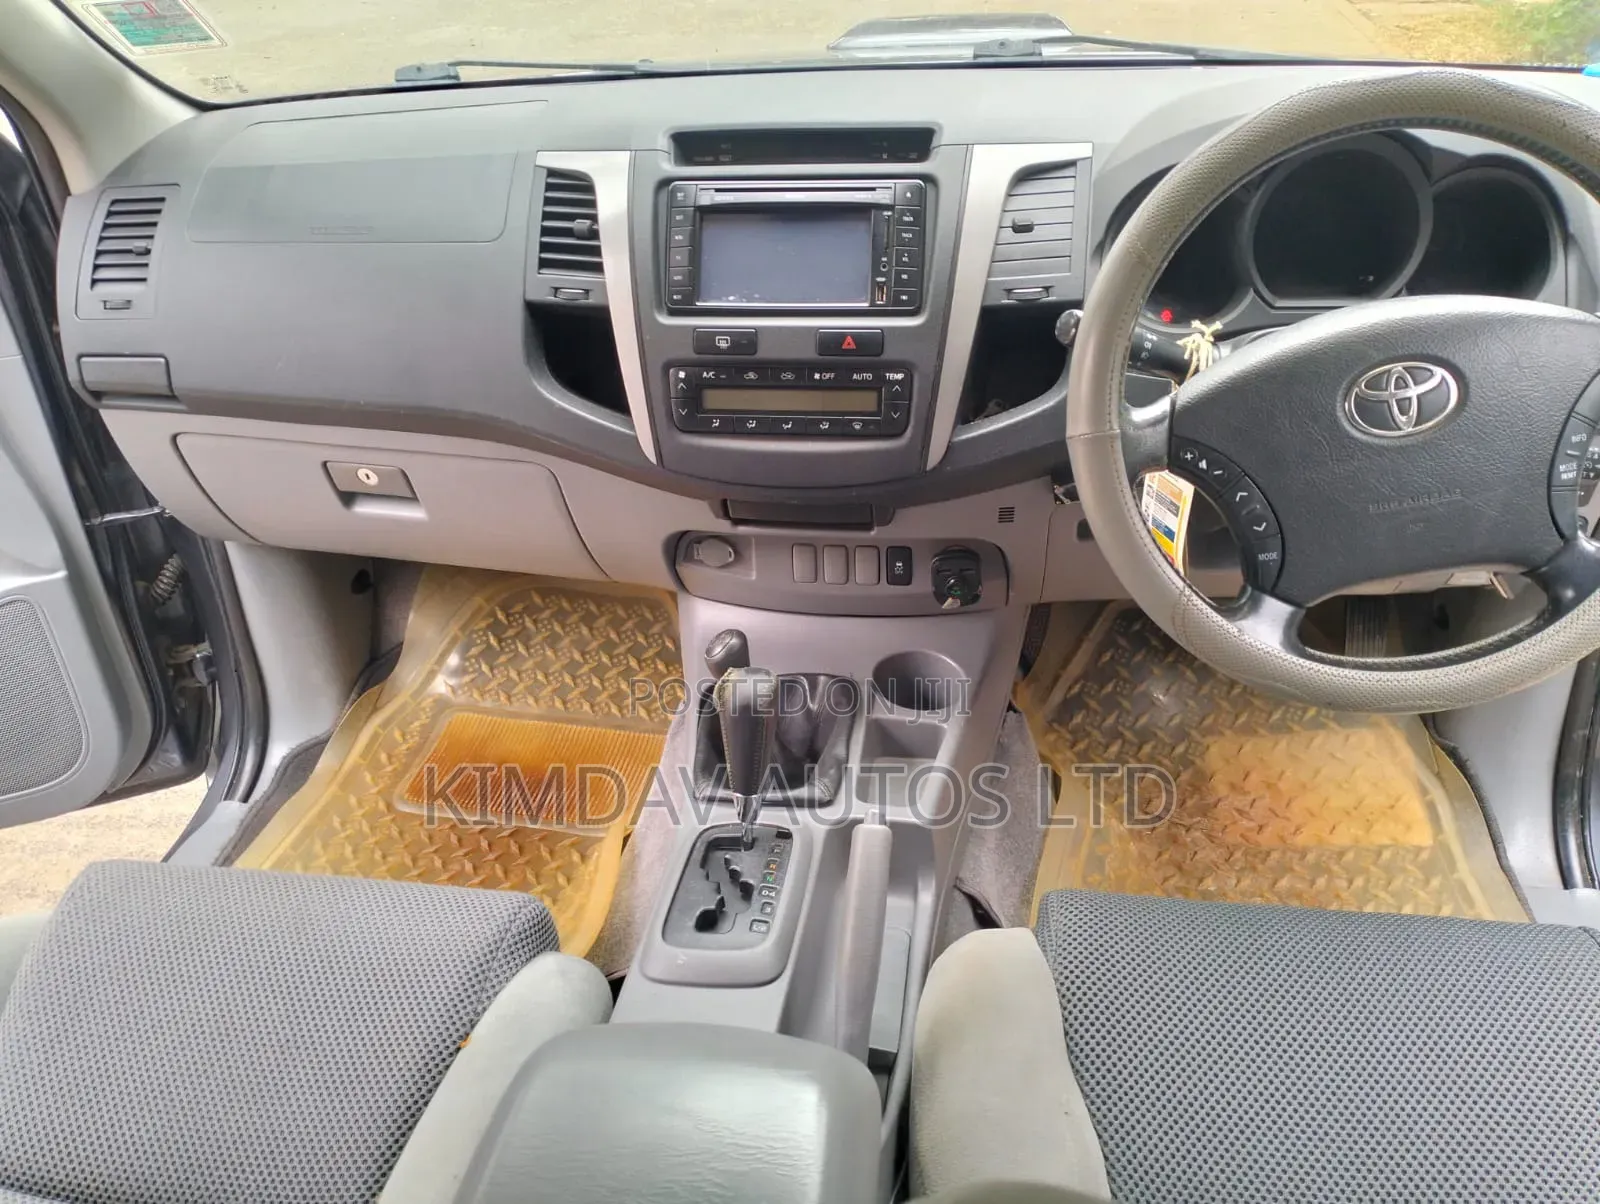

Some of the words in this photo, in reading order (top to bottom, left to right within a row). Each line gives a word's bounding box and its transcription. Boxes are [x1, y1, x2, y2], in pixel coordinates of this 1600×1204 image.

[702, 371, 716, 379] A/C
[821, 372, 836, 380] OFF
[852, 372, 873, 381] AUTO
[885, 372, 905, 381] TEMP
[1258, 551, 1278, 561] MODE
